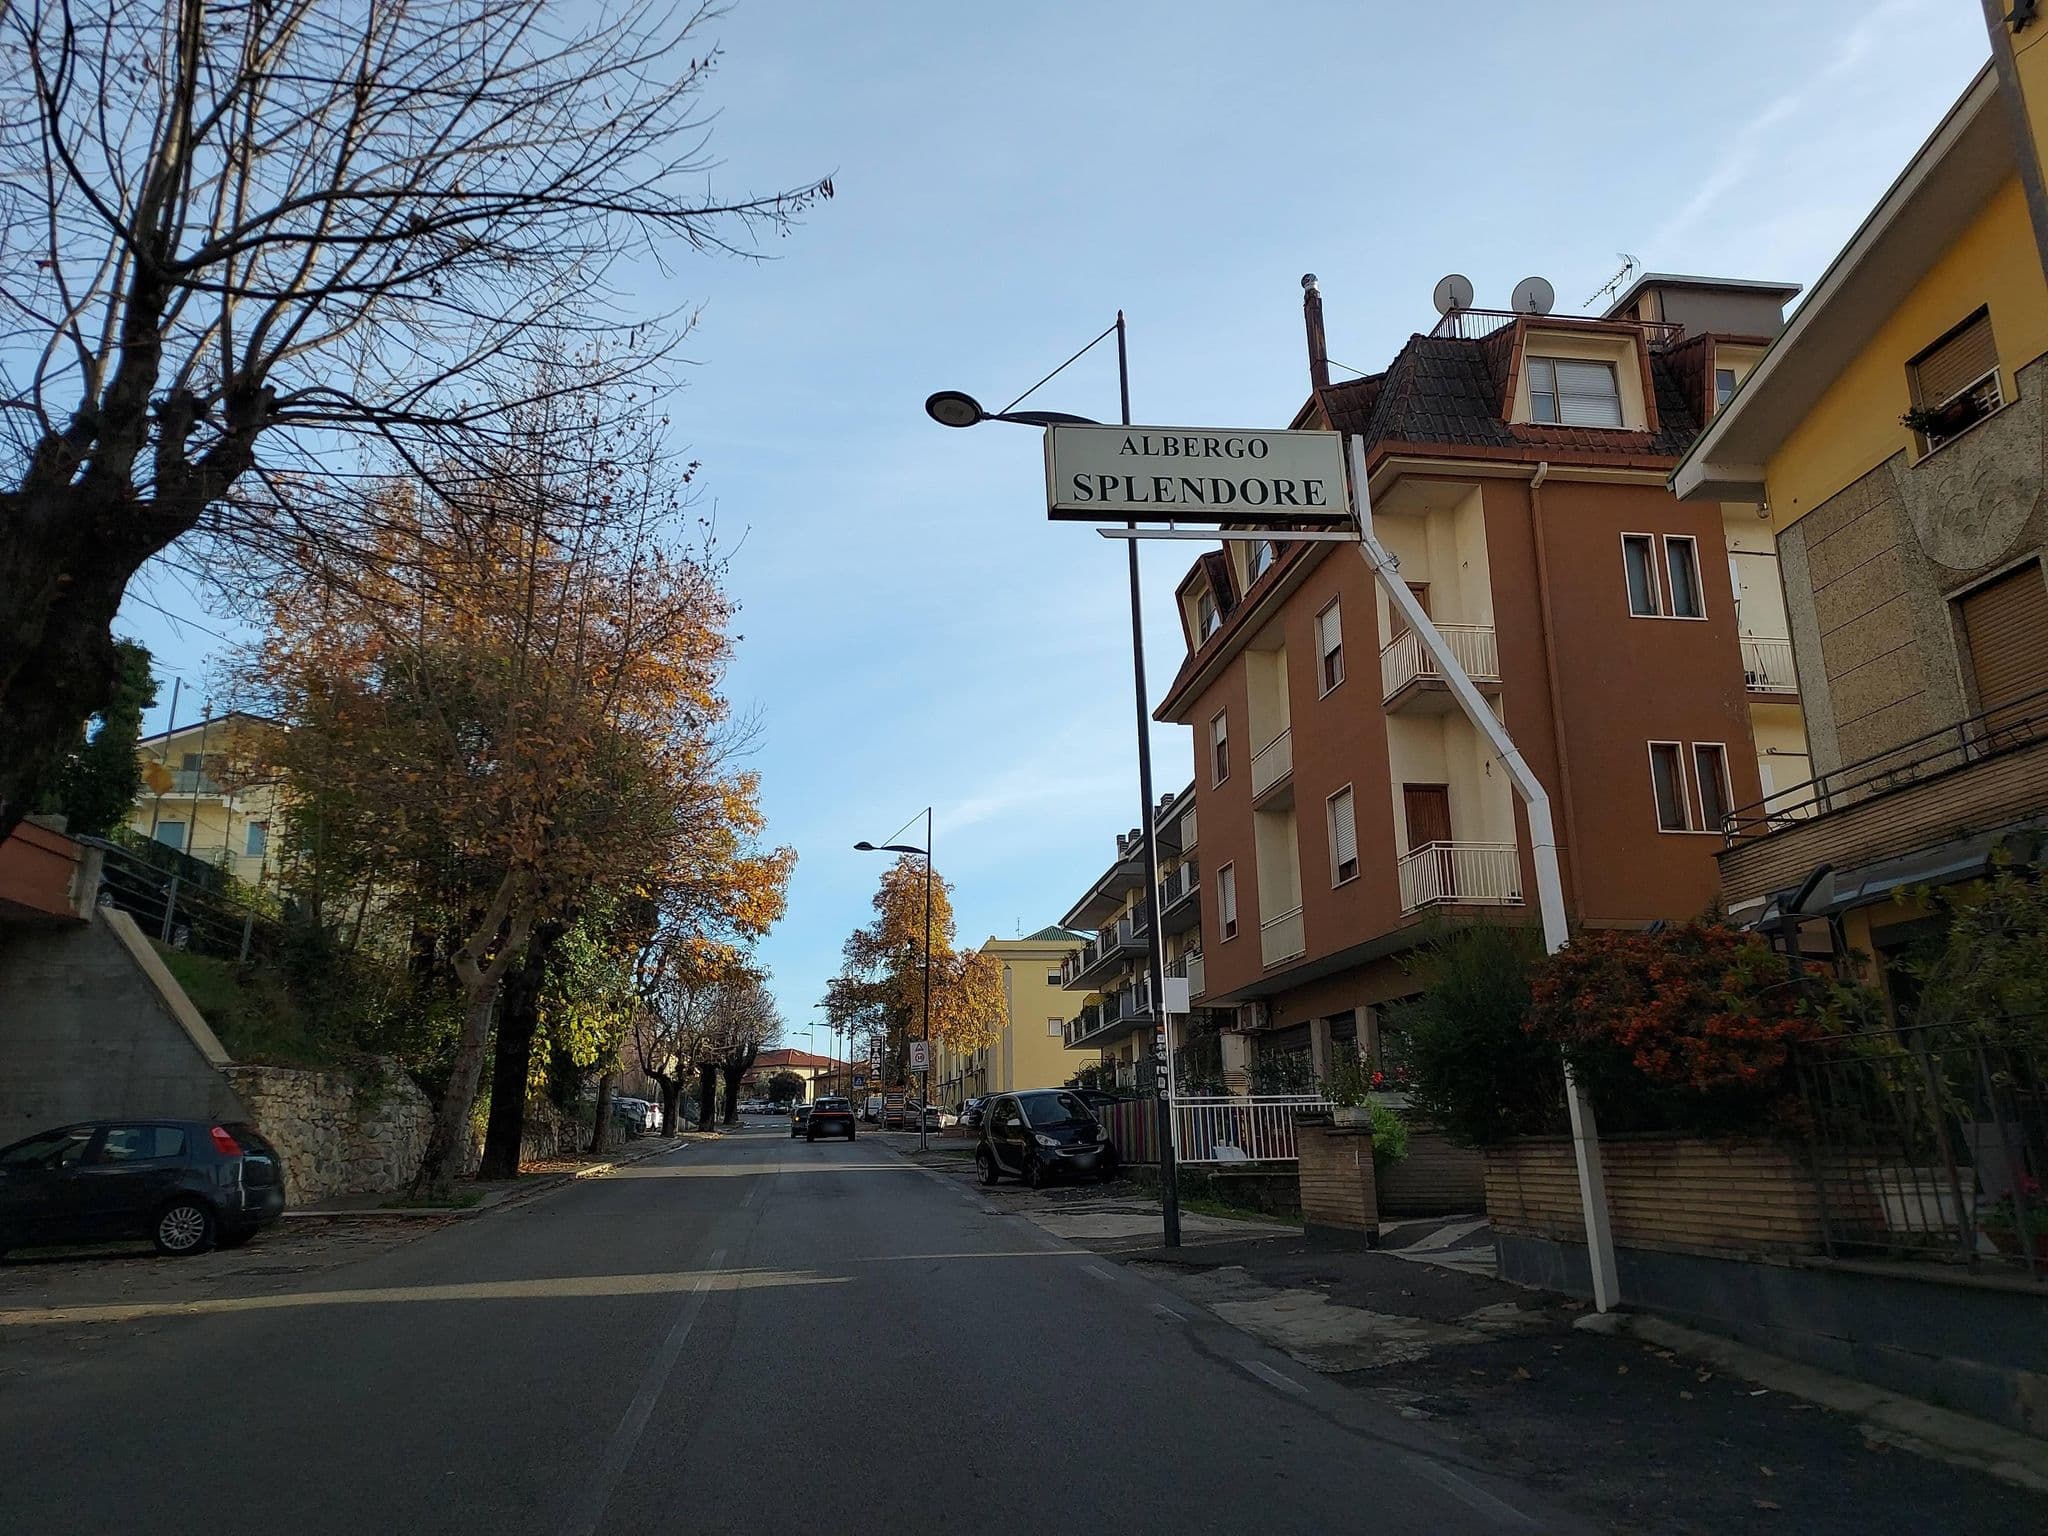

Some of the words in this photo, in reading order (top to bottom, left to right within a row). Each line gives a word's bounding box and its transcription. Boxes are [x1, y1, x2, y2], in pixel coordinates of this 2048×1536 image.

[1119, 435, 1269, 459] ALBERGO
[1073, 473, 1327, 506] SPLENDORE
[871, 1040, 881, 1076] STAMPA
